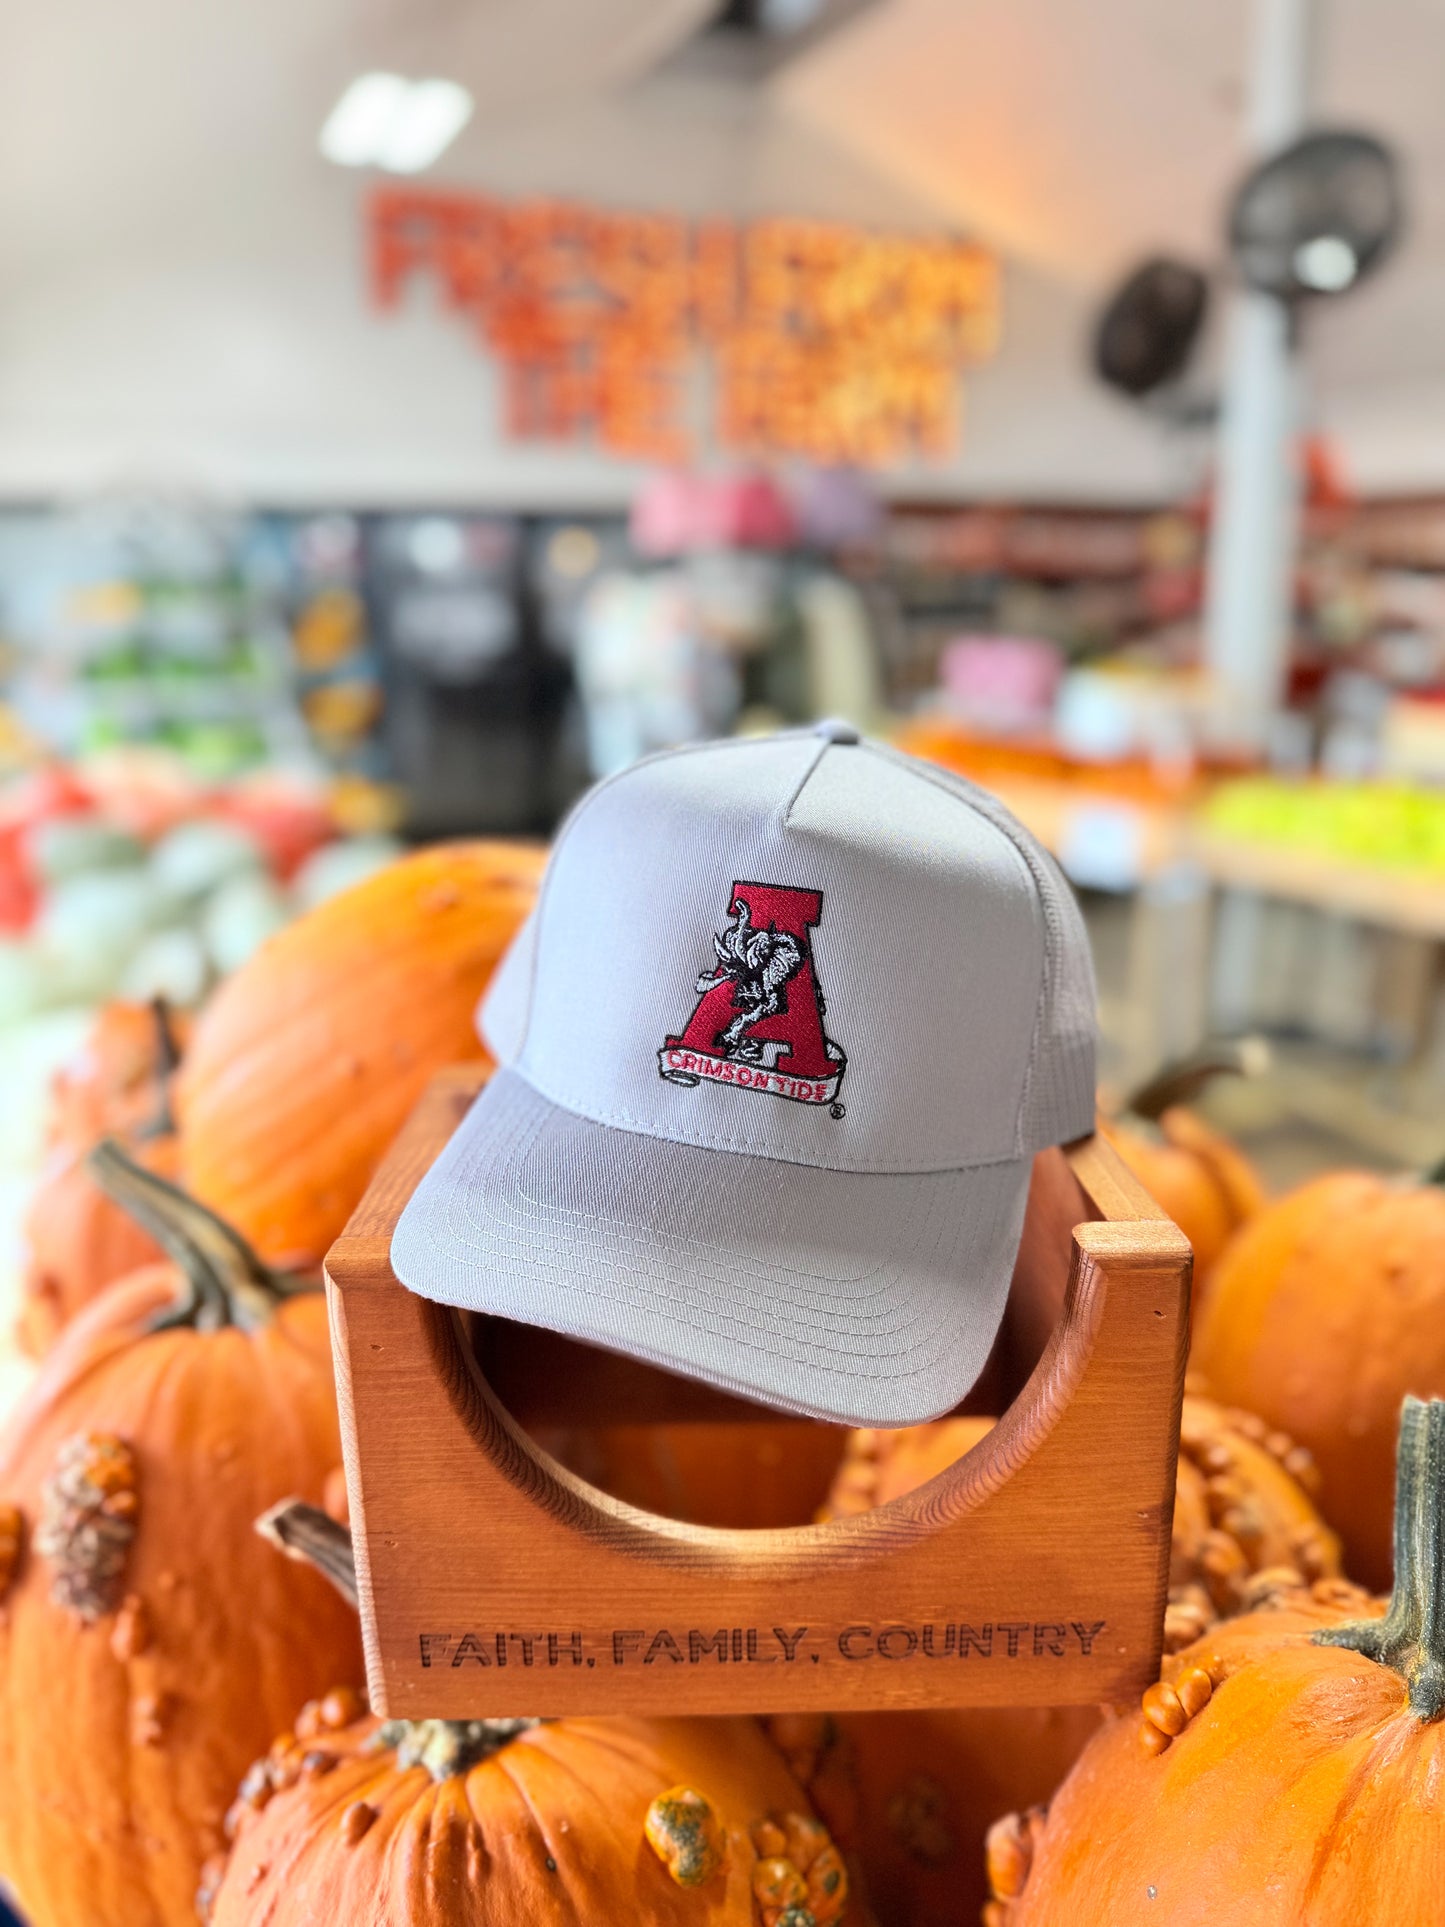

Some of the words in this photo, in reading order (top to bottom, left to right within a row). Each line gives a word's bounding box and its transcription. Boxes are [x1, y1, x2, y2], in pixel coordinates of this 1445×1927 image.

[666, 1050, 769, 1089] CRIMSON
[773, 1075, 827, 1102] TIDE
[838, 1620, 1106, 1660] COUNTRY
